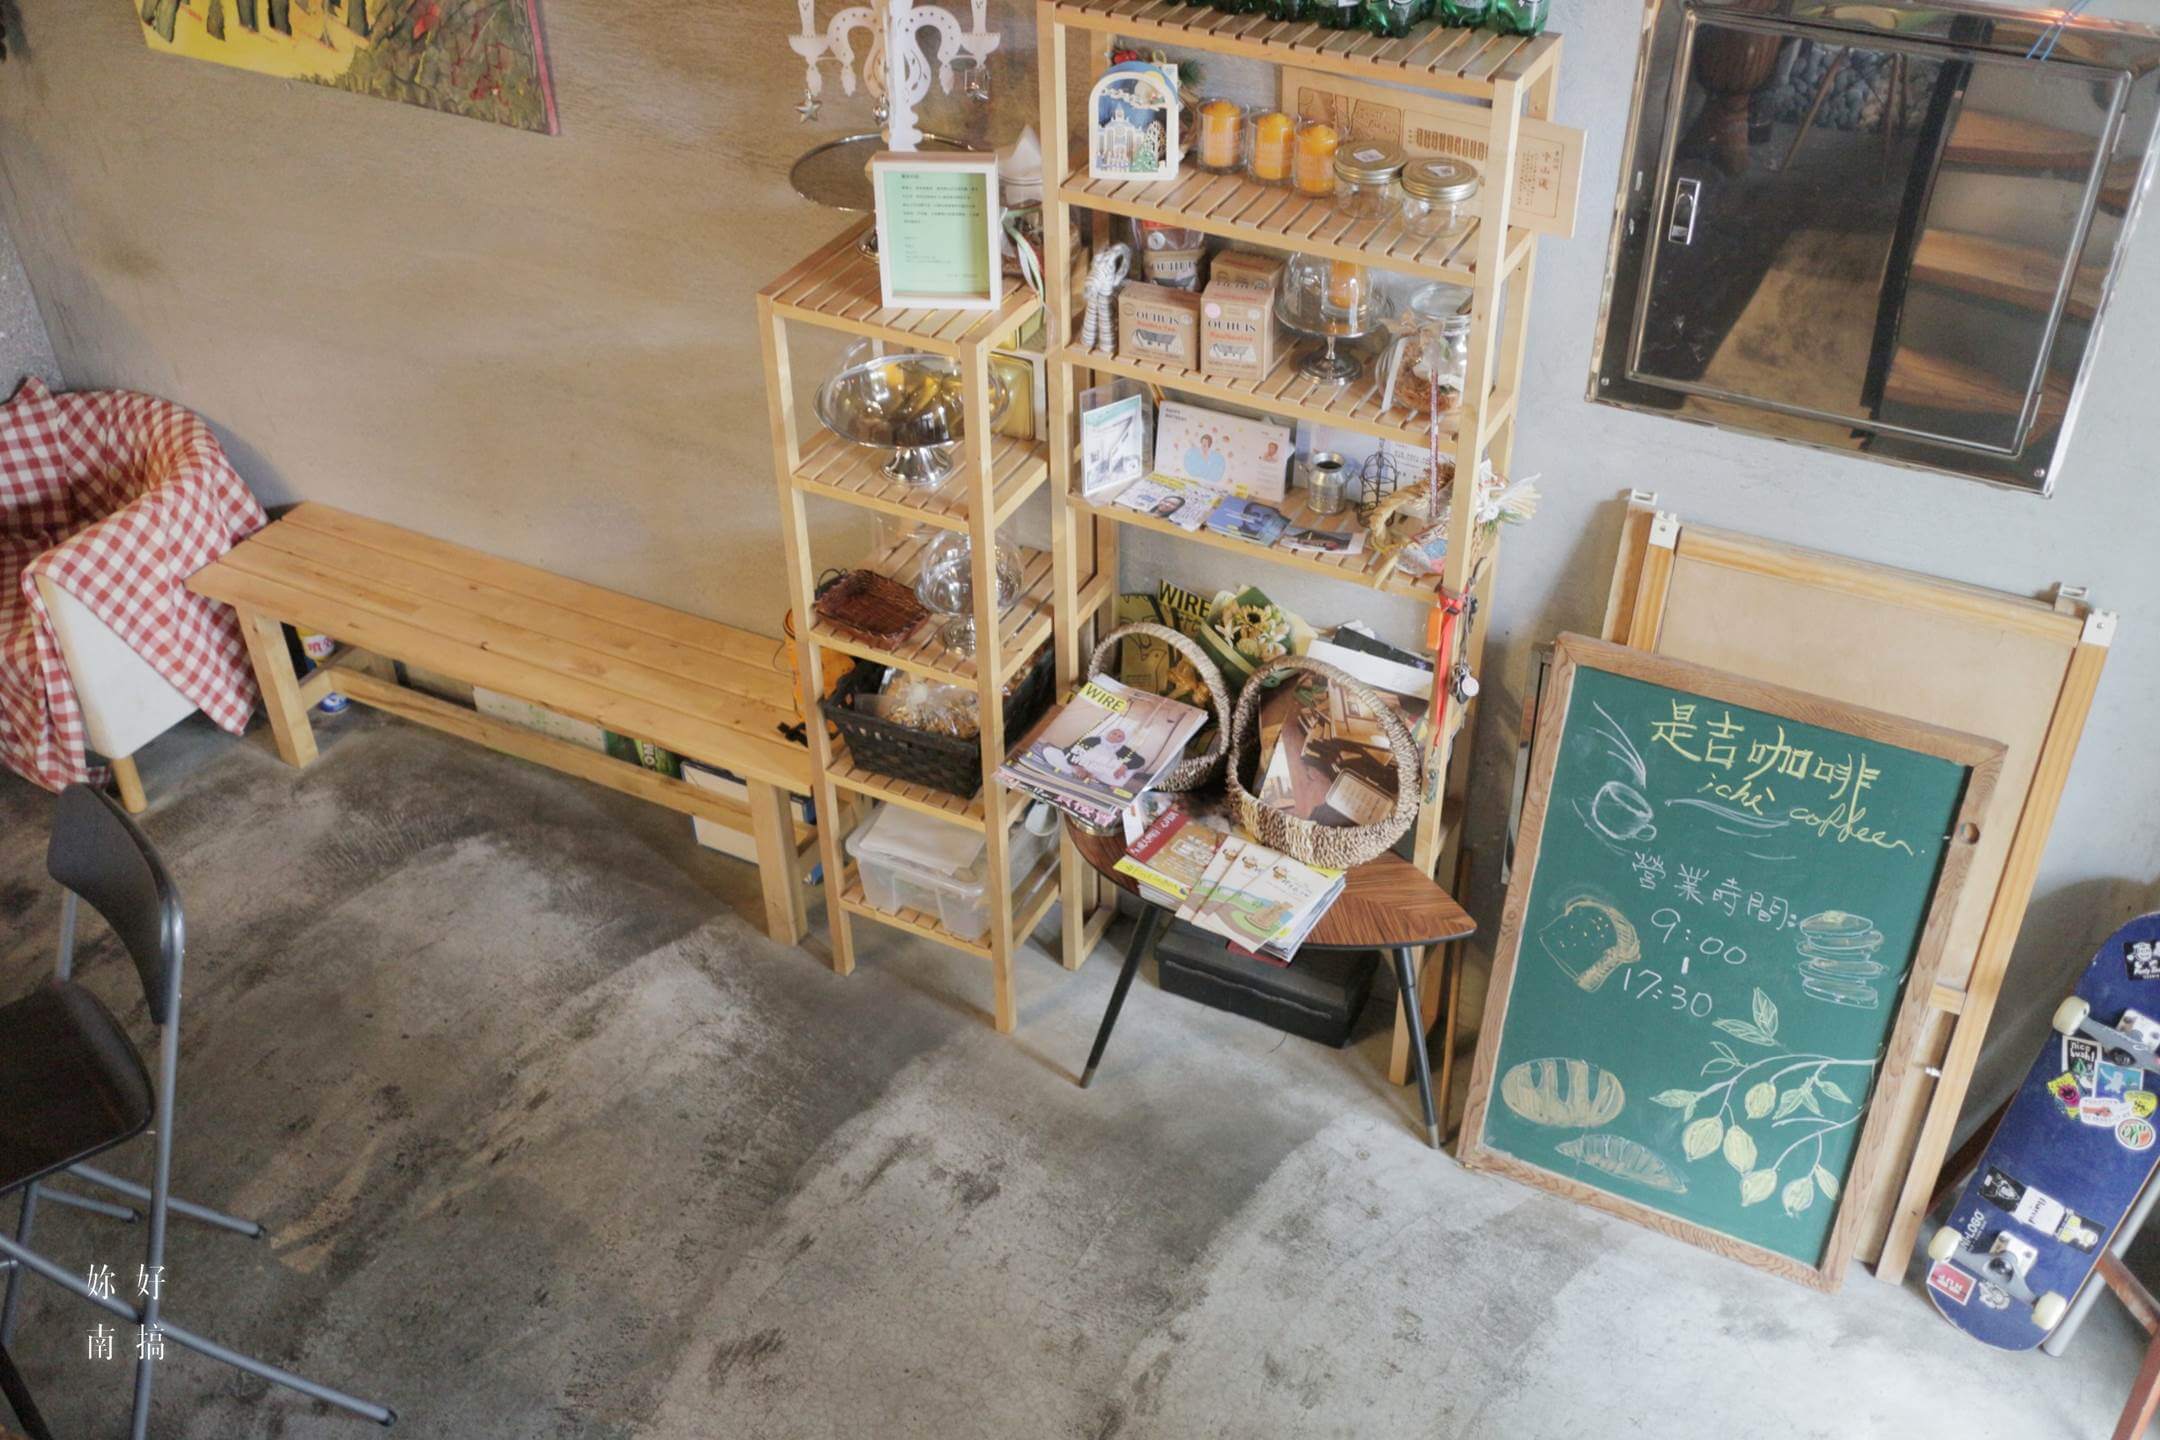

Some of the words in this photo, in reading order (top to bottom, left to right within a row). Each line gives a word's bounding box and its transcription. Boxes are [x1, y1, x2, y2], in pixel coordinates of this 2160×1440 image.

[1160, 579, 1212, 618] WIRE
[1085, 684, 1126, 712] WIRE
[1650, 698, 1881, 808] 是吉咖啡
[1650, 907, 1747, 965] 9:00
[1623, 967, 1713, 1018] 17:30
